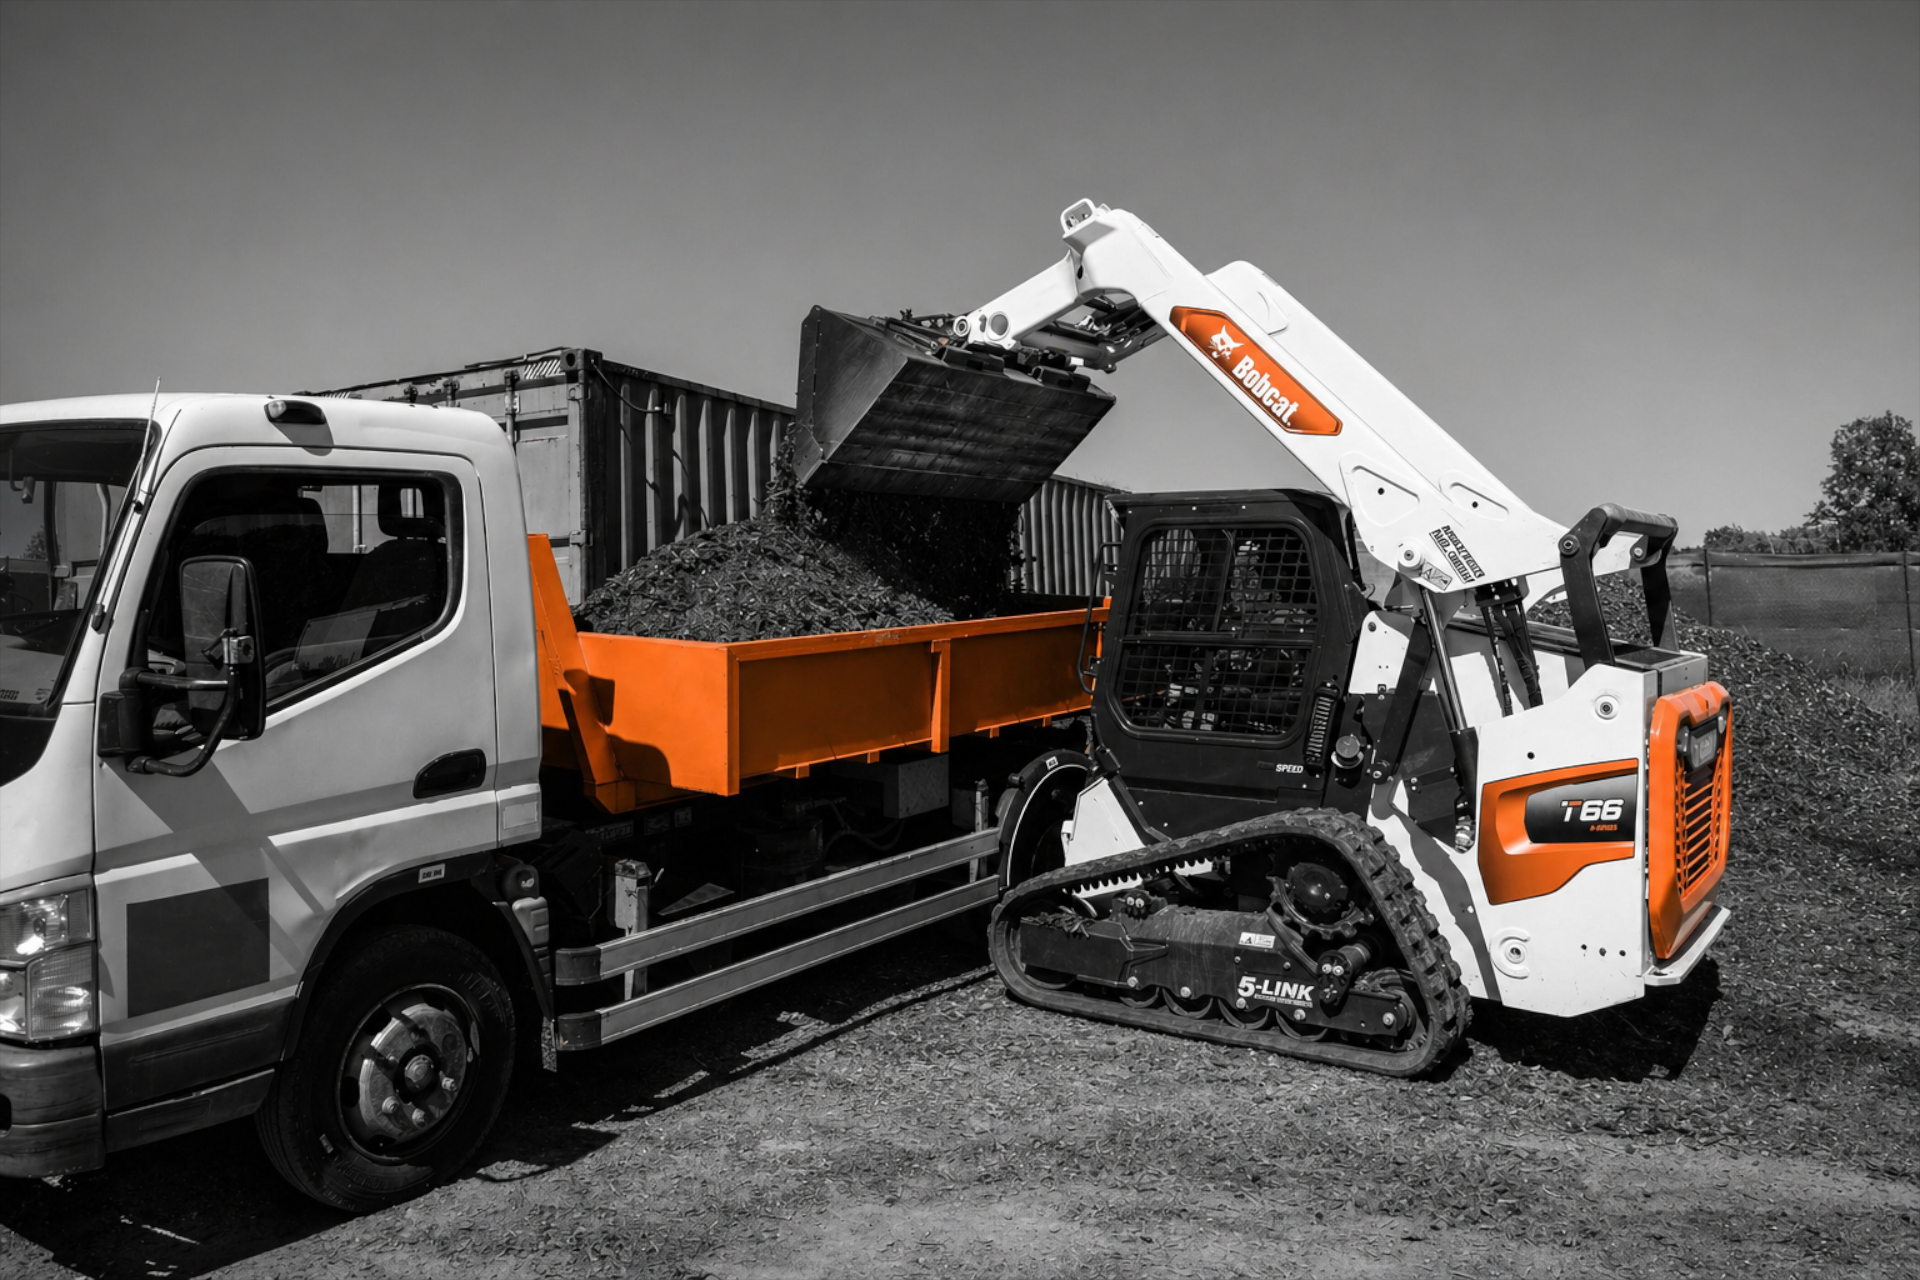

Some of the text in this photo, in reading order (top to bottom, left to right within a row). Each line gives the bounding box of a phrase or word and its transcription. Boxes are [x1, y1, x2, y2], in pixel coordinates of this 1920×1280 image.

[1275, 763, 1304, 774] SPEED
[1561, 799, 1624, 822] T66
[1237, 975, 1315, 1001] 5-LINK
